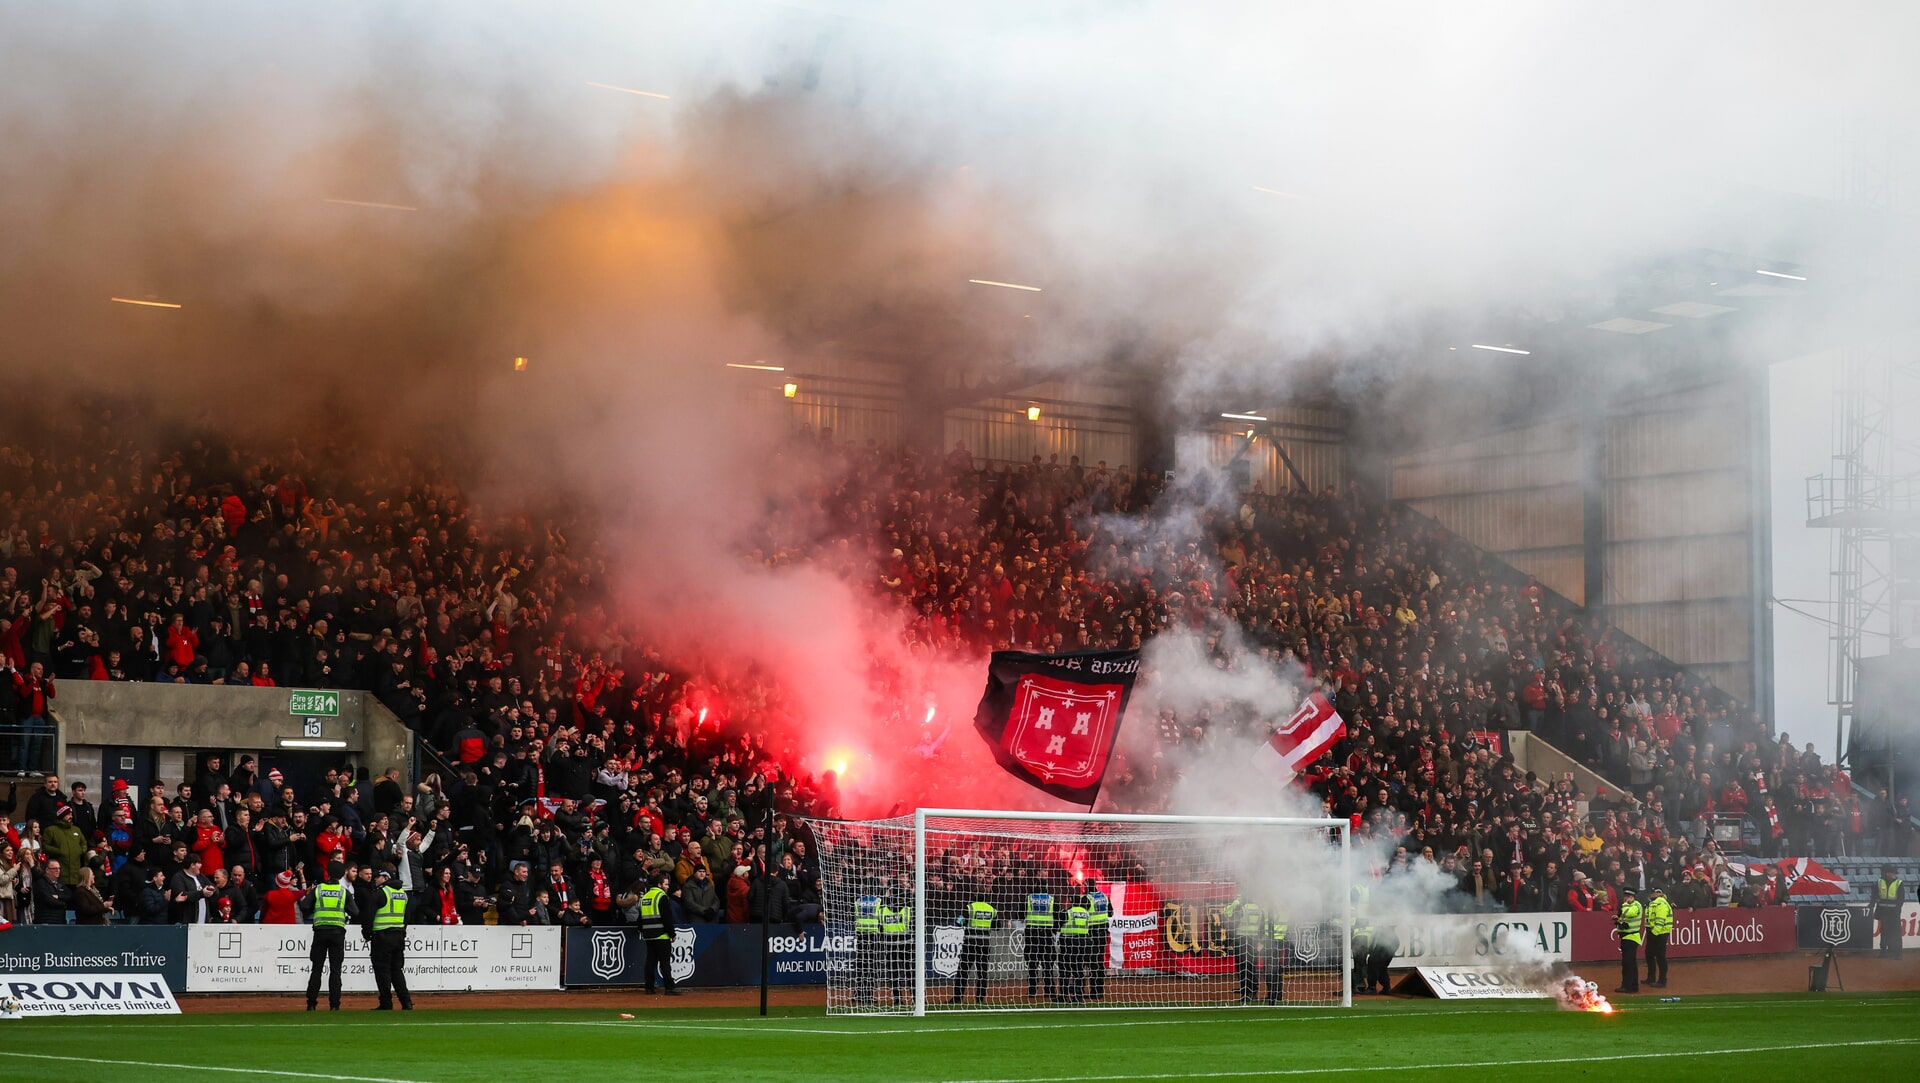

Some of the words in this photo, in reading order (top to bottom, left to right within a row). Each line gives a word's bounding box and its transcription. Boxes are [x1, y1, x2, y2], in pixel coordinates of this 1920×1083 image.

[292, 694, 306, 702] Fire
[292, 702, 306, 711] Exit
[308, 724, 319, 735] 15
[1862, 908, 1871, 917] 17
[1705, 917, 1764, 944] Woods
[278, 939, 306, 951] JON
[404, 939, 478, 951] RCHITECT
[768, 935, 806, 953] 1893
[44, 952, 118, 967] Businesses
[121, 951, 166, 967] Thrive
[670, 945, 694, 964] 893
[195, 965, 214, 974] JON
[217, 965, 264, 974] FRULLANI
[276, 964, 297, 975] TEL:
[300, 964, 314, 975] +4
[350, 964, 366, 975] 224
[401, 964, 478, 976] ww.jfarchitect.co.uk
[490, 965, 507, 973] JON
[510, 965, 553, 973] FRULLANI
[776, 961, 804, 973] MADE
[805, 961, 815, 972] IN
[1446, 972, 1519, 987] CRO
[0, 981, 166, 1001] ROWN
[19, 1001, 66, 1013] neering
[69, 1001, 121, 1011] services
[123, 1000, 172, 1010] limited
